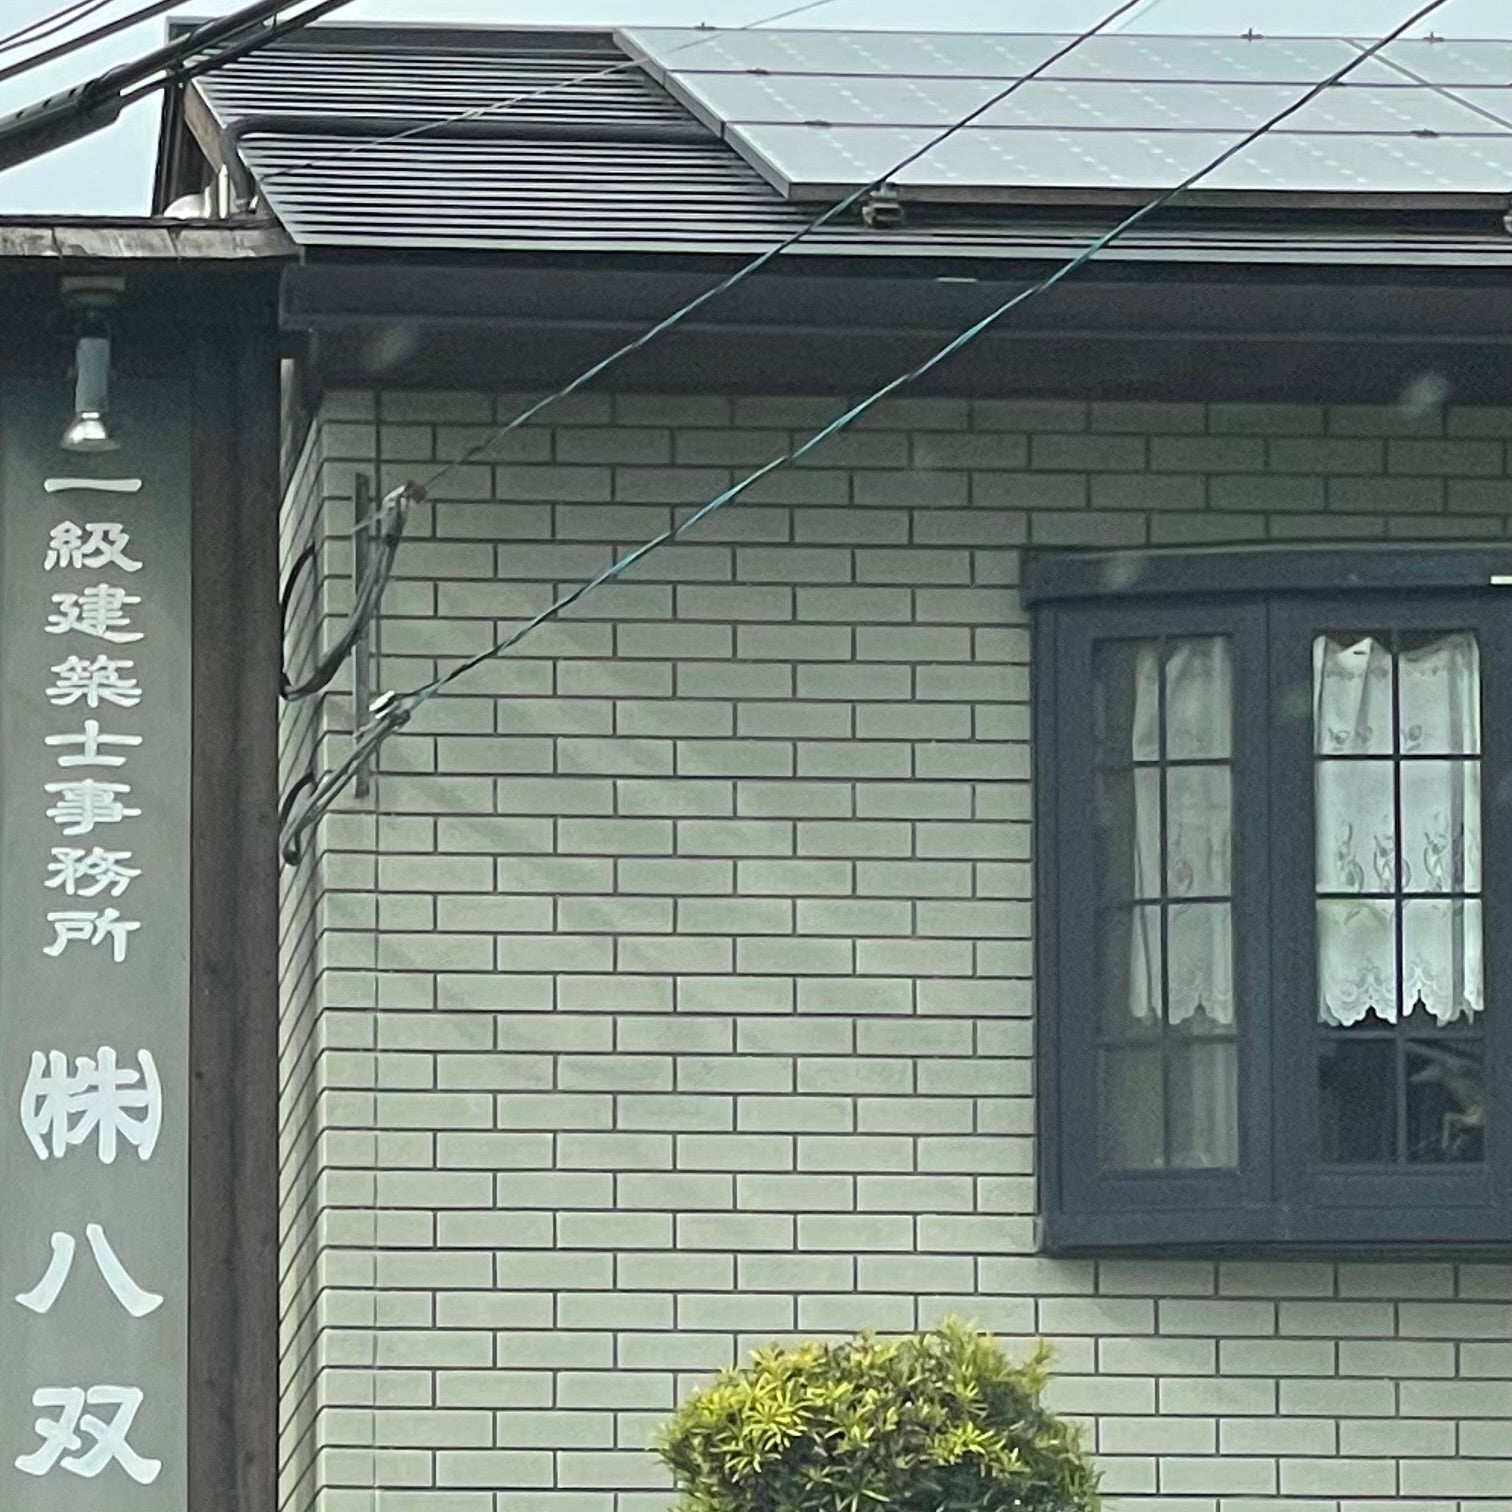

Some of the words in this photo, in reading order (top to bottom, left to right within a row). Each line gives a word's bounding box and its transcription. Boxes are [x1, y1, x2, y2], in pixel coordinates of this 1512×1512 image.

[43, 477, 145, 962] 一級建築士事務所
